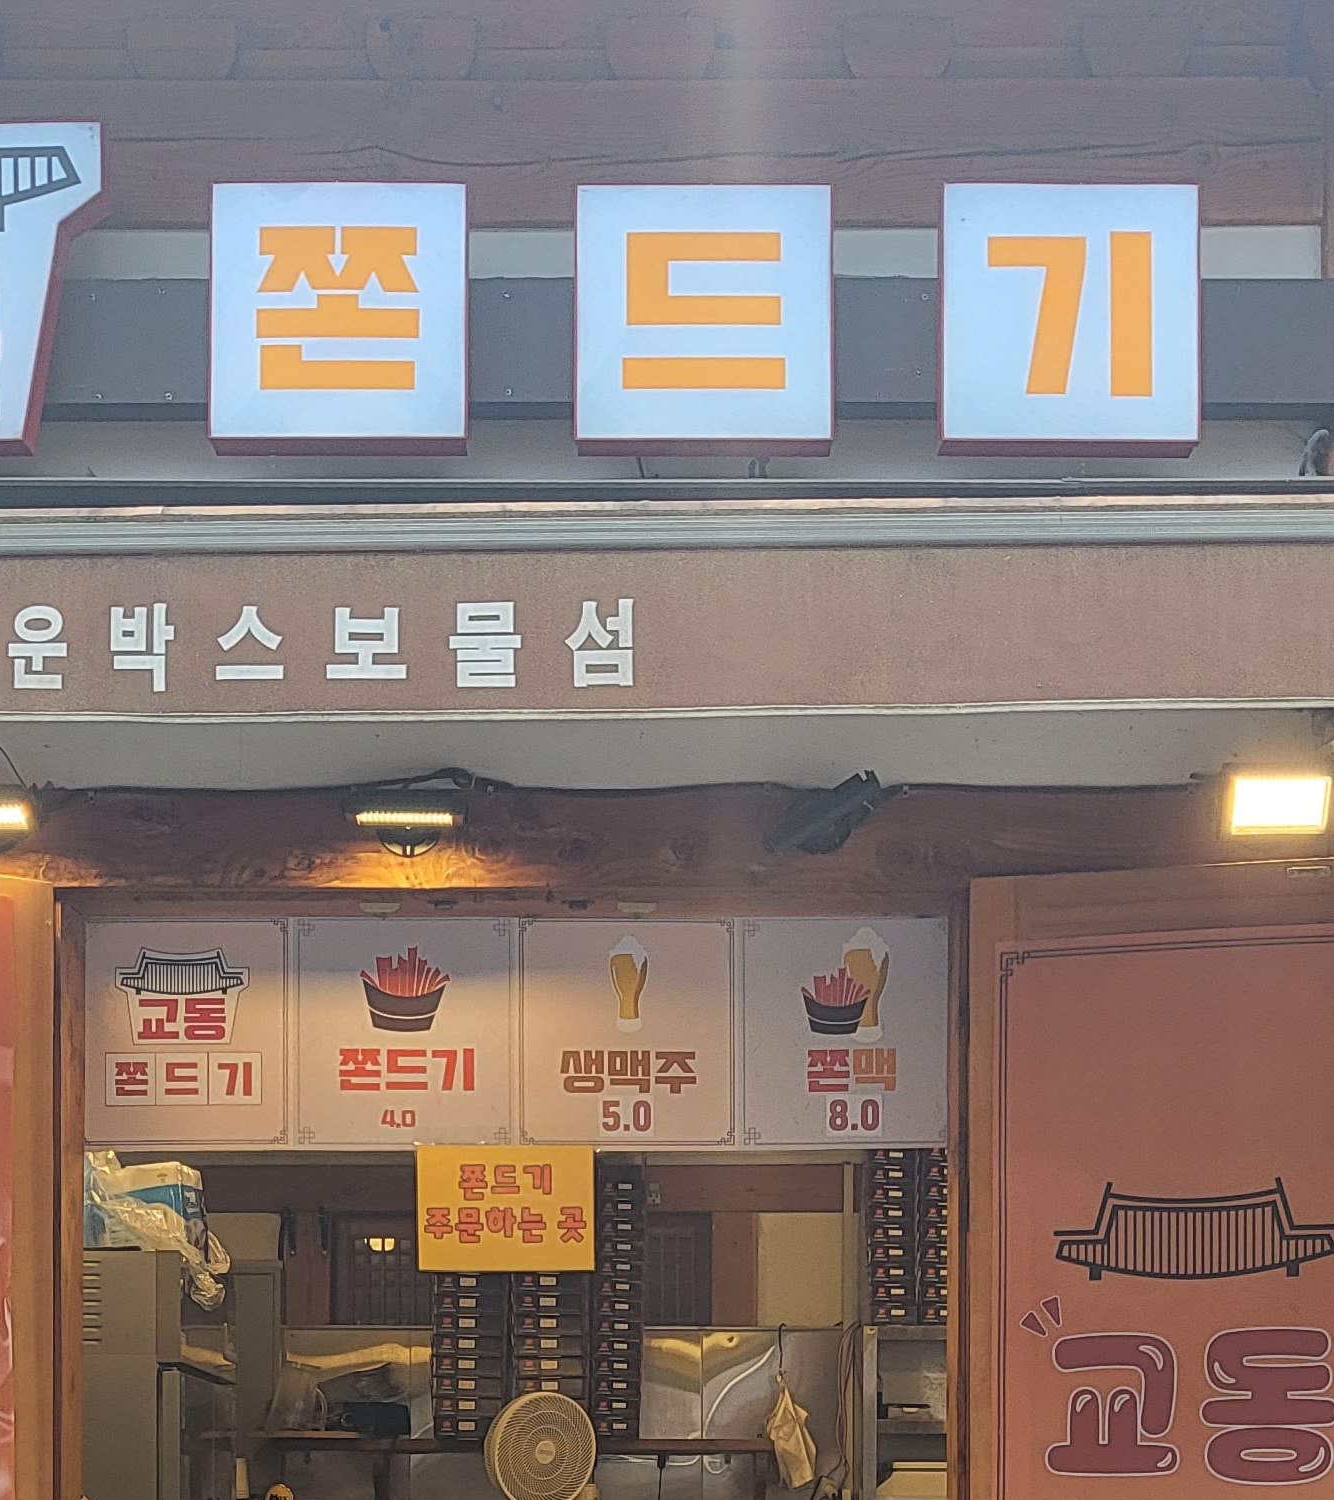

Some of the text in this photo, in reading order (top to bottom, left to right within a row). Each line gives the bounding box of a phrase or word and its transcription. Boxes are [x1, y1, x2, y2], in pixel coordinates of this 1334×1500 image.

[255, 224, 1154, 399] 쫀드기
[137, 997, 227, 1041] 교동
[114, 1061, 253, 1097] 쫀드기
[338, 1047, 476, 1092] 쫀드기
[560, 1049, 698, 1095] 생맥주
[806, 1047, 897, 1093] 쫀맥
[380, 1109, 417, 1129] 4.0
[600, 1100, 653, 1132] 5.0
[828, 1099, 881, 1132] 8.0
[458, 1162, 554, 1201] 쫀드기
[423, 1205, 588, 1245] 주문하는 곳
